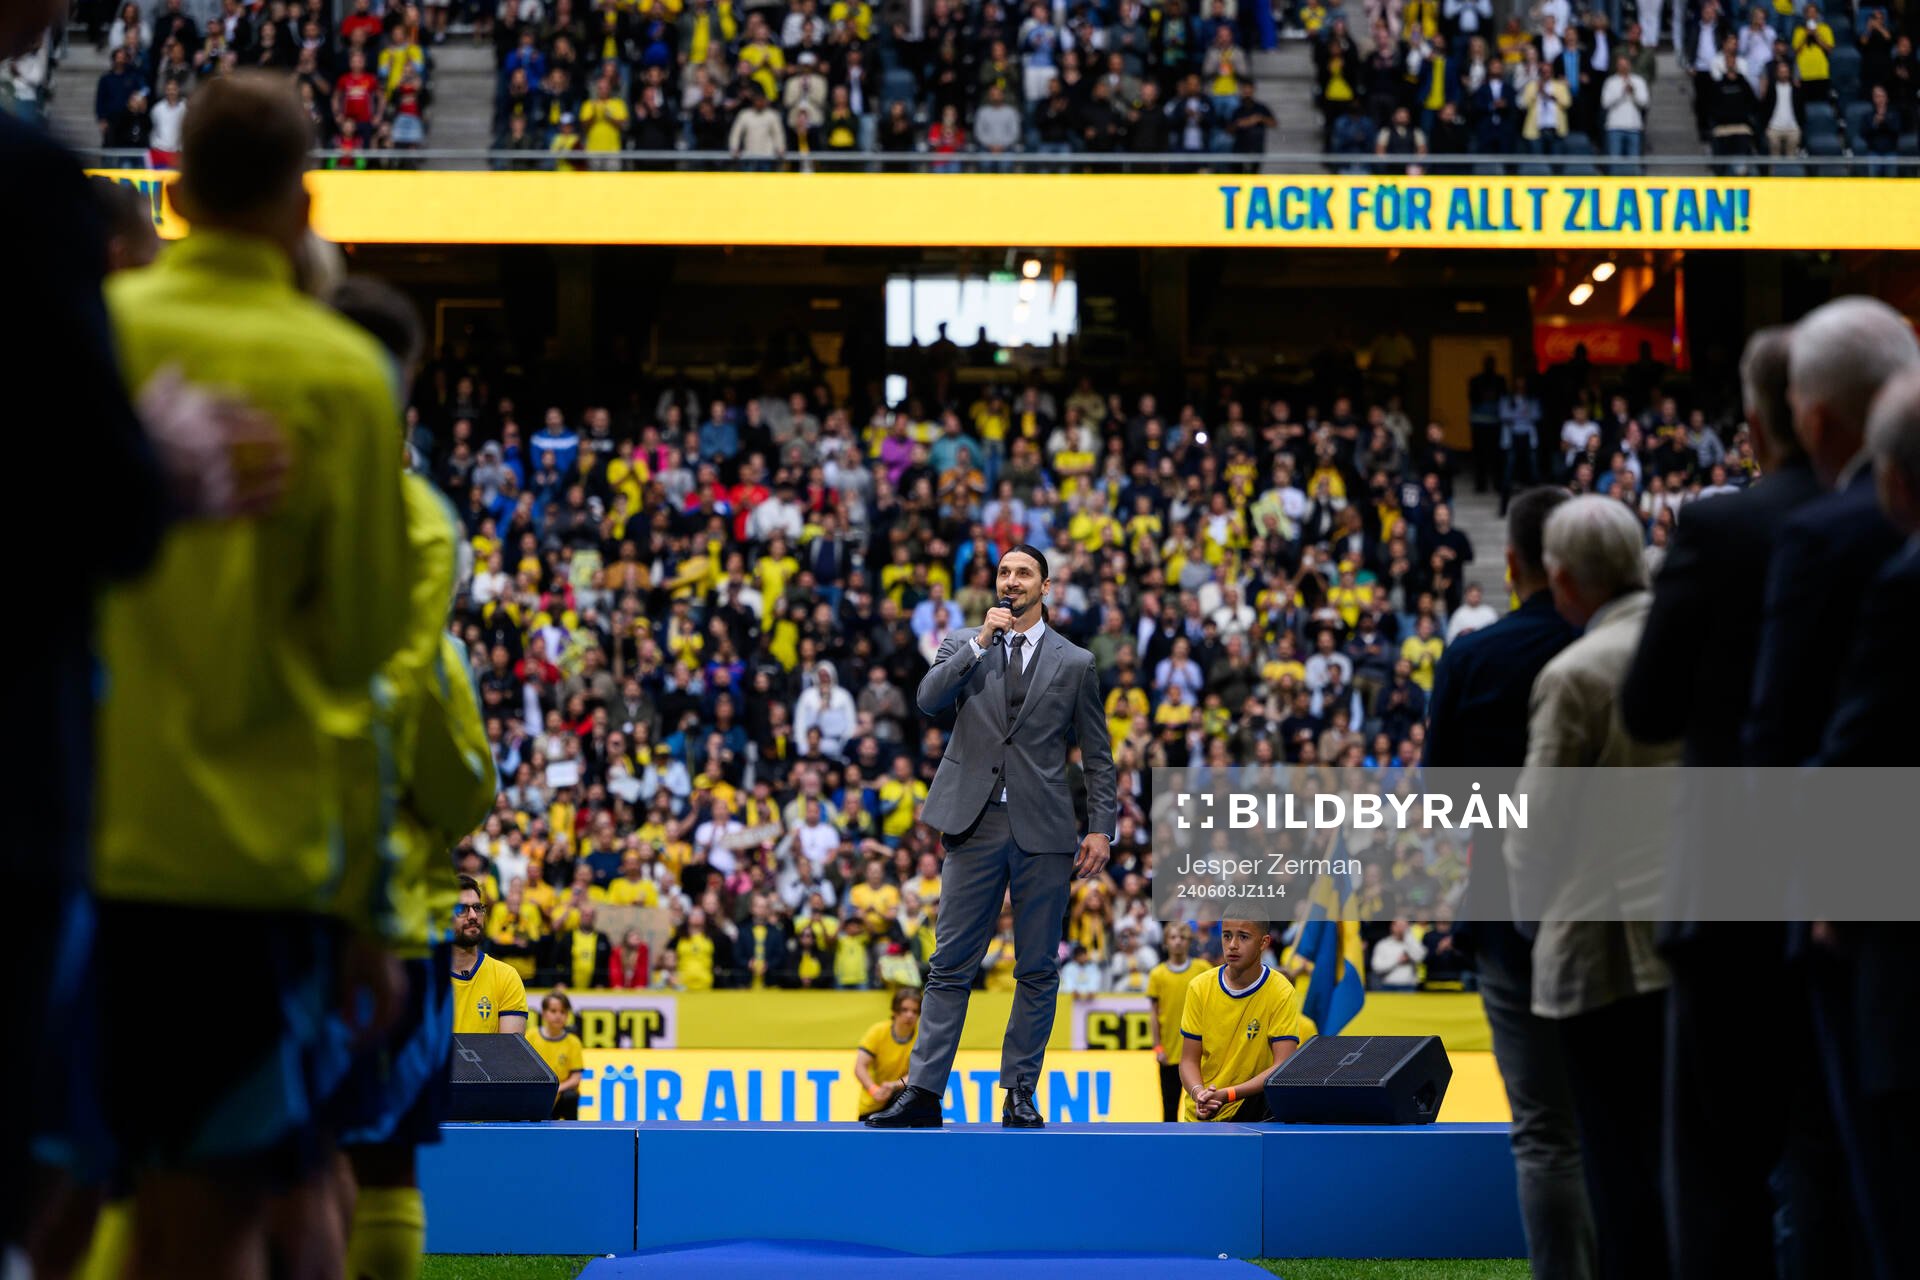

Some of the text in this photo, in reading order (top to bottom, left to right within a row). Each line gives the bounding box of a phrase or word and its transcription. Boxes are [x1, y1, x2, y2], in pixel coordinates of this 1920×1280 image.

[1219, 184, 1750, 232] TACK FÖR ALLT ZLATAN!
[577, 1064, 683, 1121] ÖR
